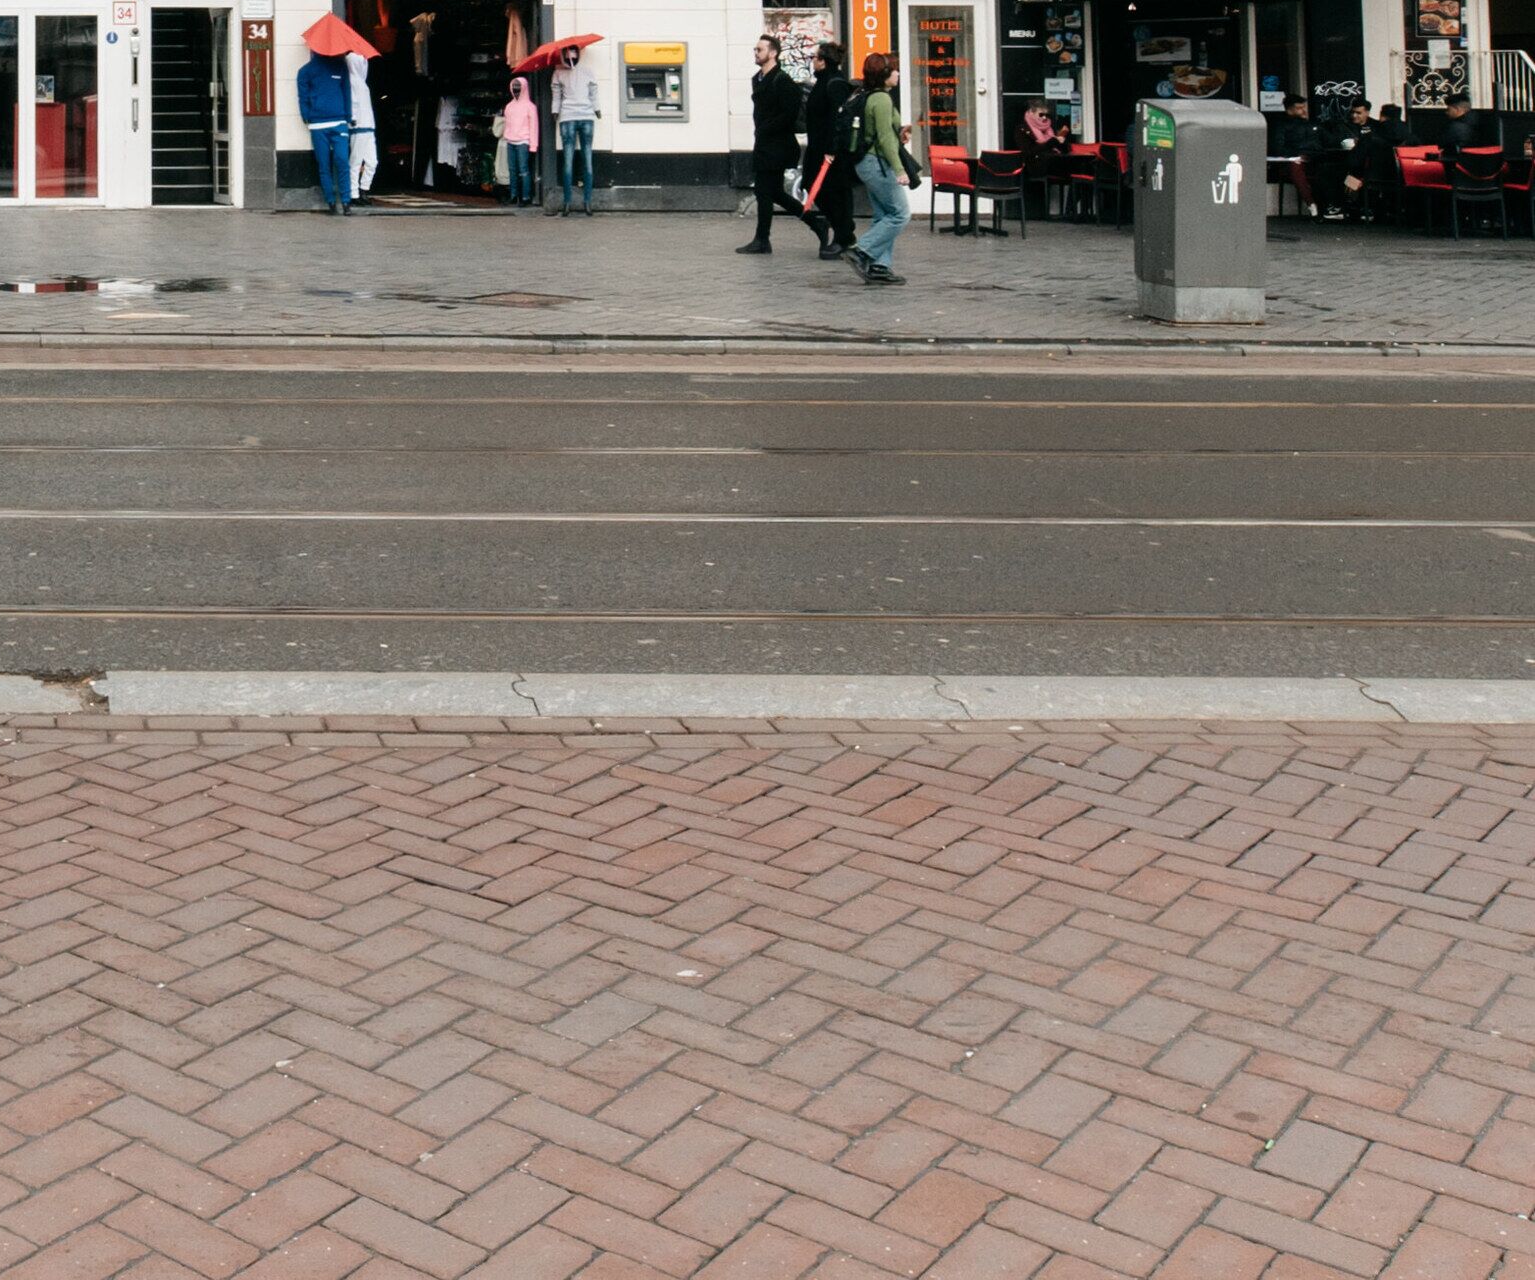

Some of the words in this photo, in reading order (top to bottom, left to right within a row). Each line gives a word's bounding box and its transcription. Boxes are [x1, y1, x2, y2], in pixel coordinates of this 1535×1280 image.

[117, 7, 132, 19] 34
[919, 21, 961, 30] HOTEL
[248, 24, 268, 40] 34
[1009, 30, 1036, 38] MENU
